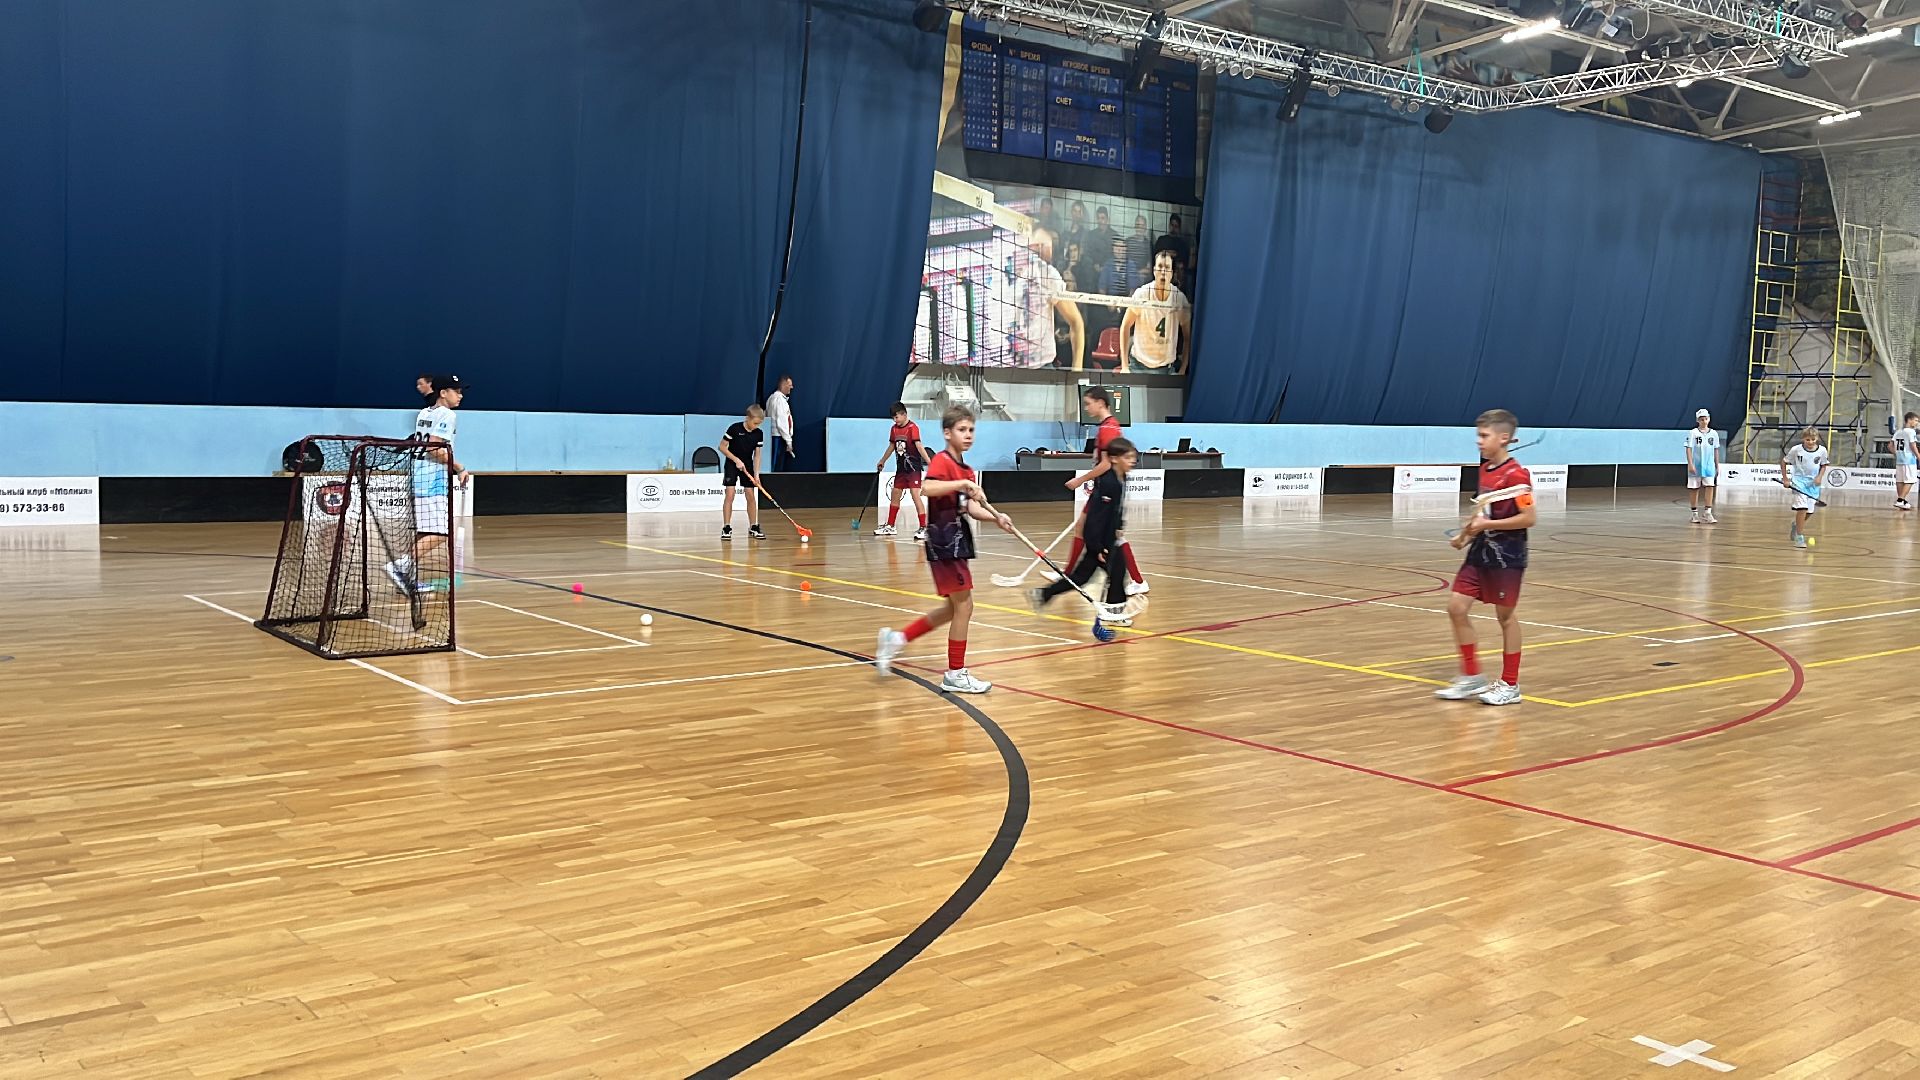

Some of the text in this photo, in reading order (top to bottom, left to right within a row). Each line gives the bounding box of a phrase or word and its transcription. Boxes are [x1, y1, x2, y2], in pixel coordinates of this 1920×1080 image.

[1020, 50, 1041, 61] ВРЕМЯ
[1155, 317, 1166, 338] 4
[1896, 438, 1905, 451] 75
[26, 487, 48, 496] клуб
[49, 487, 93, 496] «Молния»
